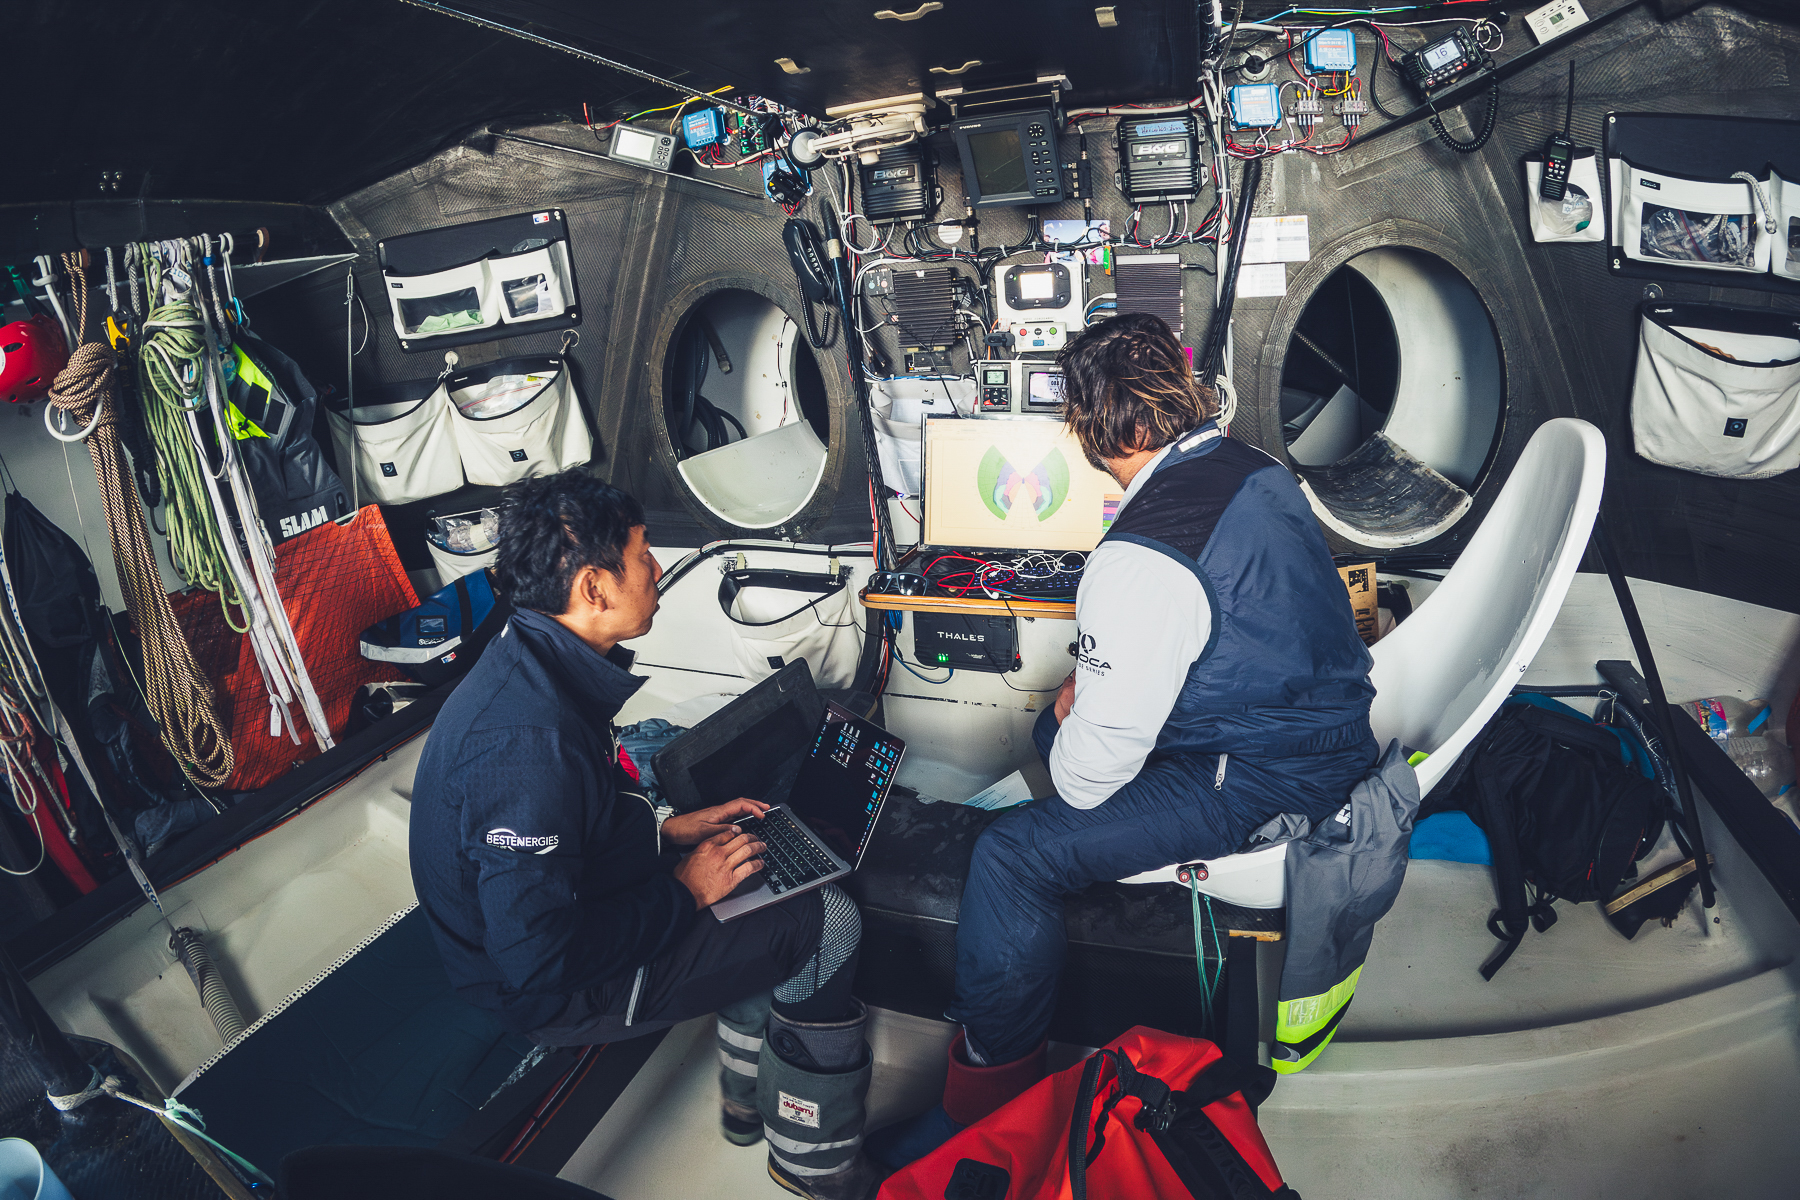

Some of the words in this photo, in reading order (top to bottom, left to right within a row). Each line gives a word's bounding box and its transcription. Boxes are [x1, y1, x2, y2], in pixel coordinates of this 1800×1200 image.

[1434, 47, 1448, 60] 16
[1138, 142, 1180, 155] B&G
[873, 167, 909, 180] B&G
[279, 505, 329, 538] SLAM
[936, 631, 985, 642] THALES
[1078, 653, 1112, 670] OCA
[486, 833, 559, 847] BESTENERGIES
[783, 1101, 814, 1118] dubarry
